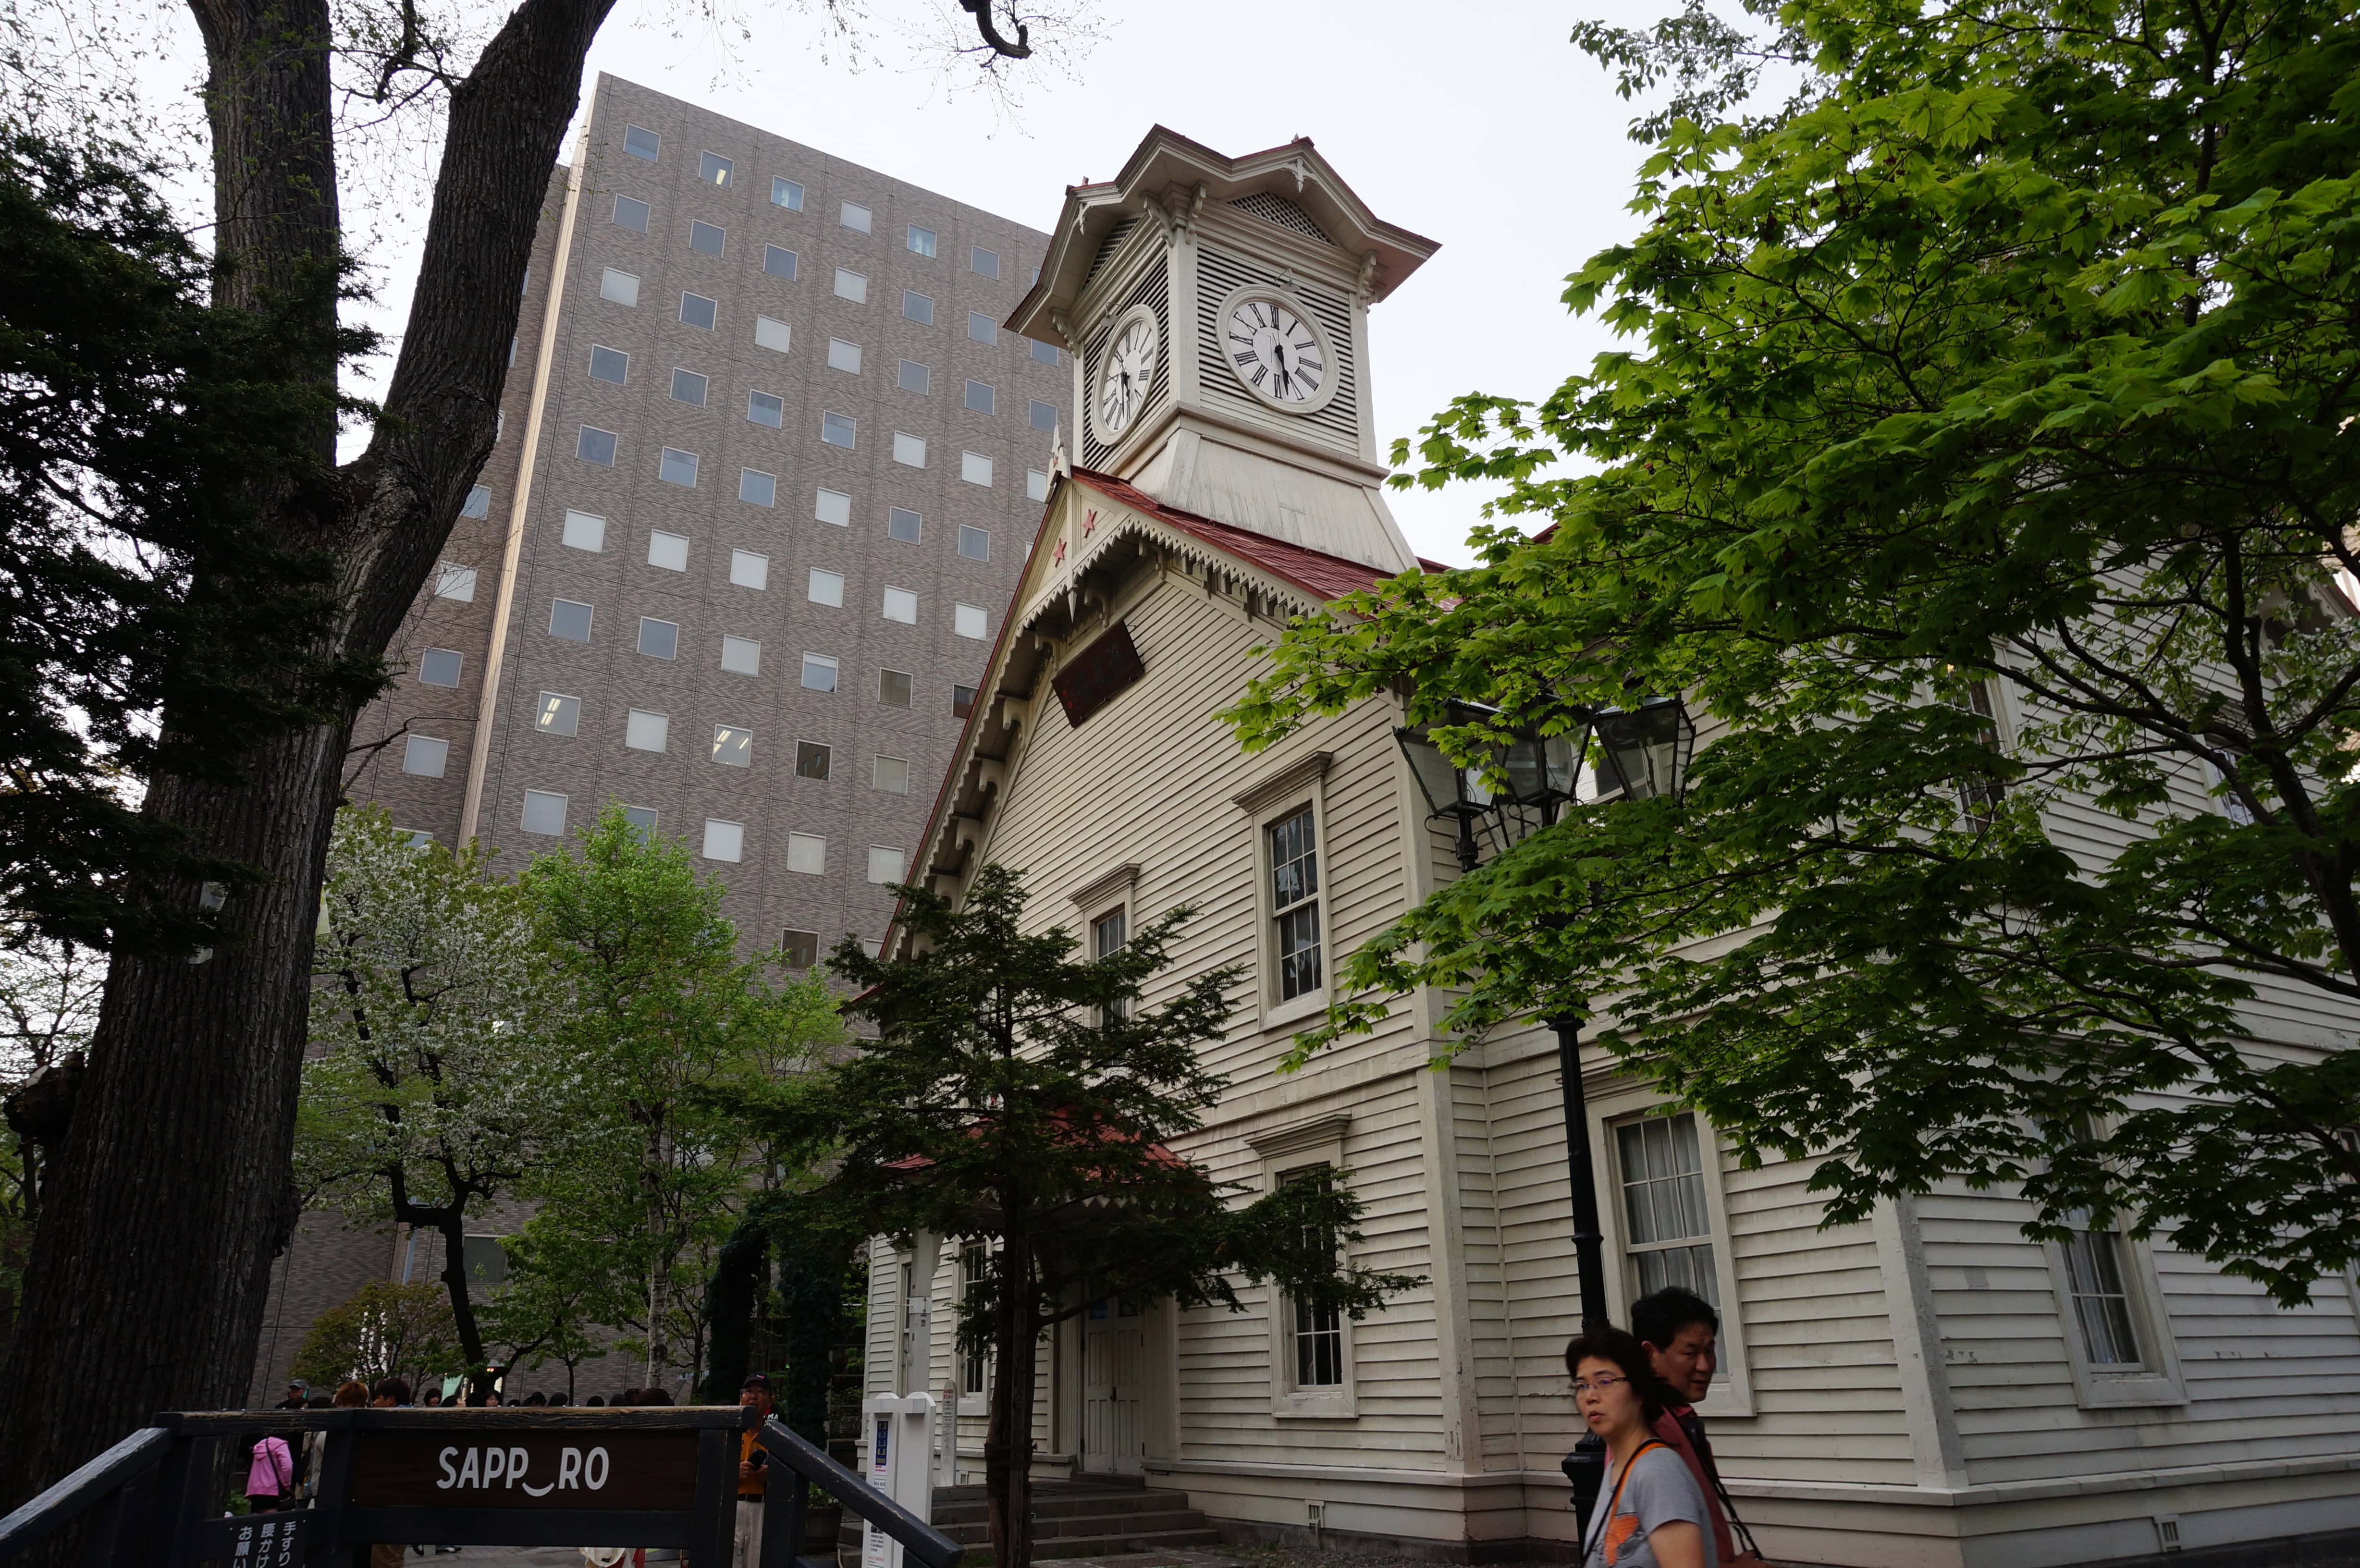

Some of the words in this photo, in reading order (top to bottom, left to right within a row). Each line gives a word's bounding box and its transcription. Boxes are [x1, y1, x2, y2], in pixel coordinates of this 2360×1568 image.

[1233, 311, 1257, 336] X
[1248, 303, 1267, 329] XI
[1269, 305, 1280, 331] XII
[1285, 319, 1299, 338] I
[1229, 331, 1253, 347] IX
[1294, 340, 1315, 350] II
[1233, 350, 1259, 367] VIII
[1299, 356, 1322, 372] III
[1250, 363, 1268, 387] VII
[1273, 373, 1283, 400] VI
[1289, 375, 1305, 400] V
[233, 1526, 253, 1568] お願い
[278, 1520, 296, 1567] 手すり
